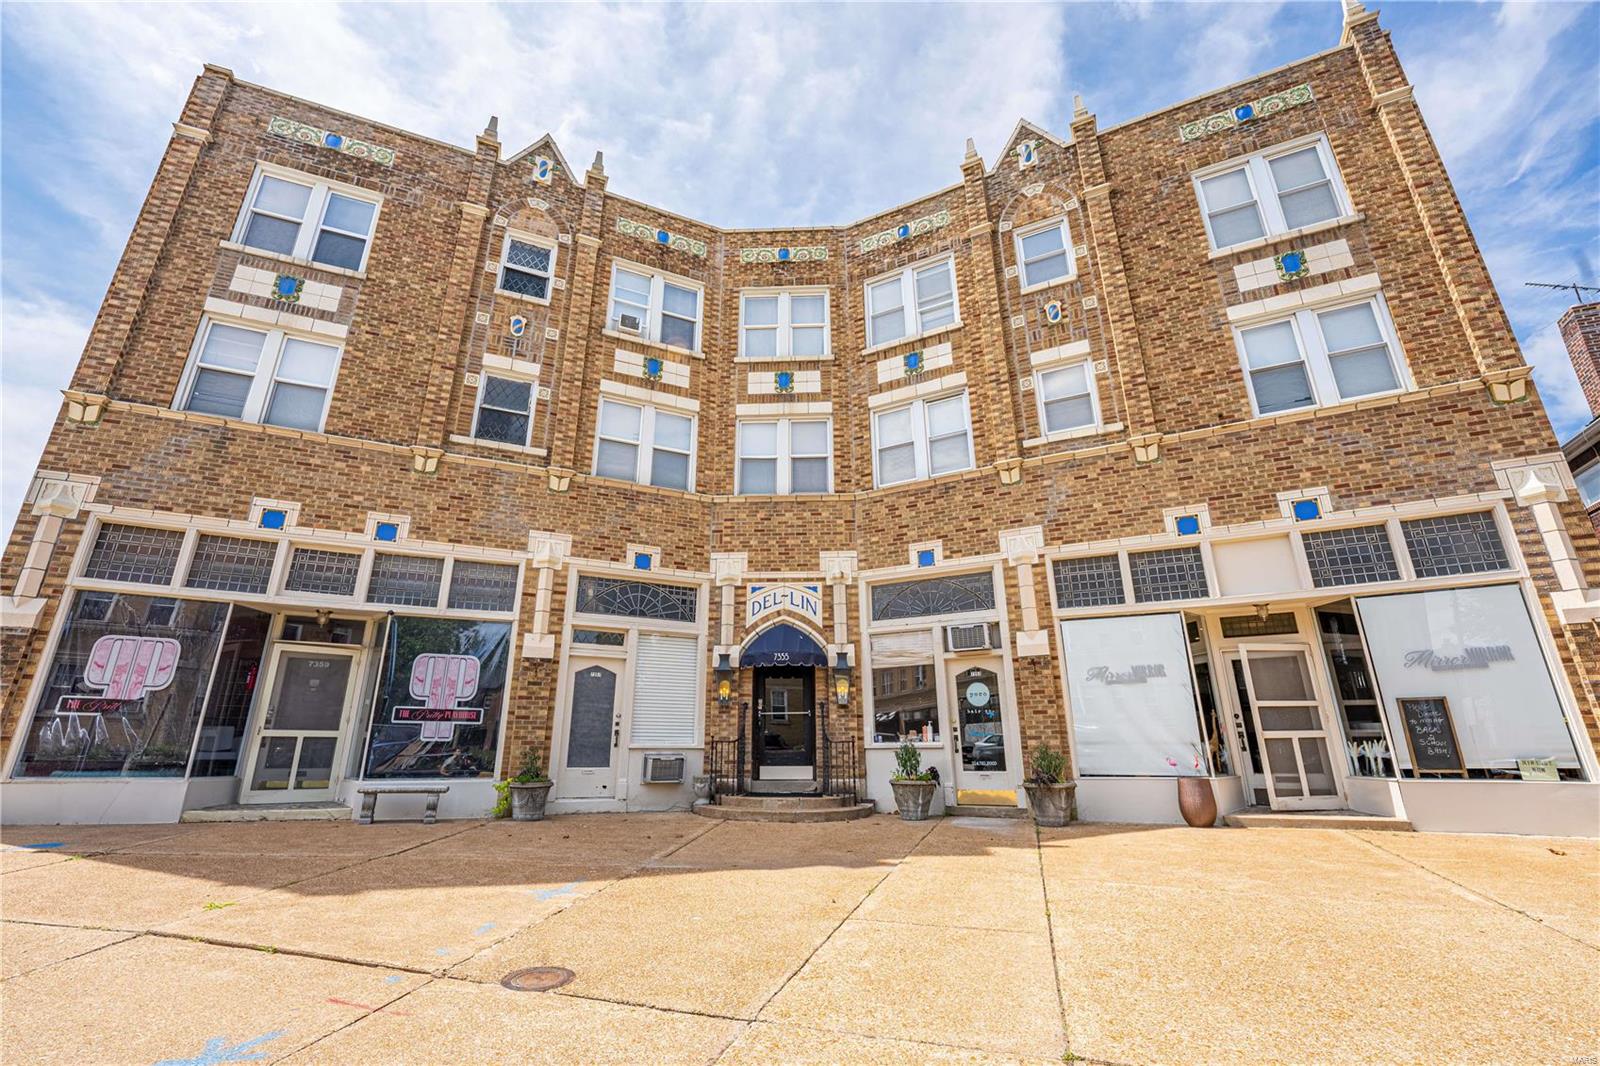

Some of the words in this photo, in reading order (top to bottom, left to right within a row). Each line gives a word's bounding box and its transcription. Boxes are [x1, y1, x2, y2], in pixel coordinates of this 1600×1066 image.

[773, 652, 790, 661] 7355
[399, 709, 410, 718] THE
[444, 711, 476, 720] PLAYHOUSE
